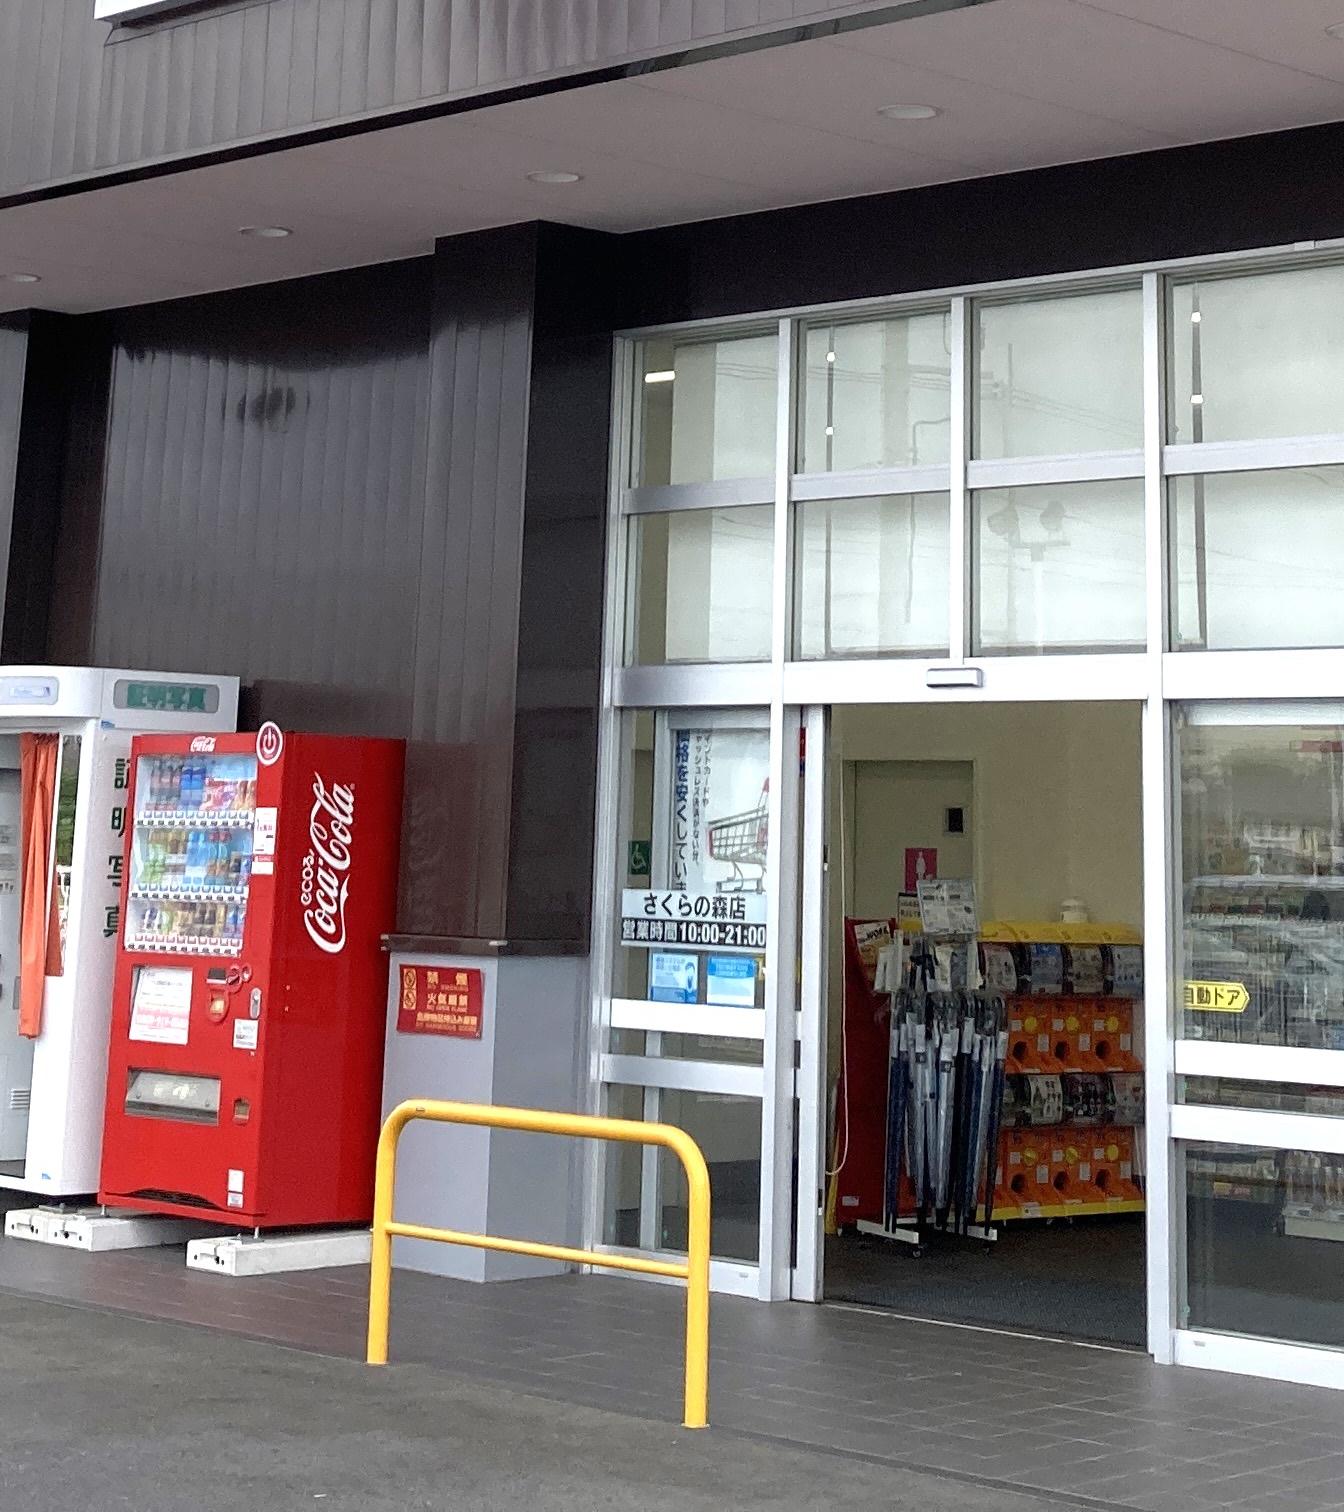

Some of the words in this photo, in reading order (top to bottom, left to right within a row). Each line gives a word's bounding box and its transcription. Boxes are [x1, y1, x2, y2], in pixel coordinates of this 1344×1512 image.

[303, 770, 356, 954] Coca-Cola
[643, 892, 746, 921] さくらの森店
